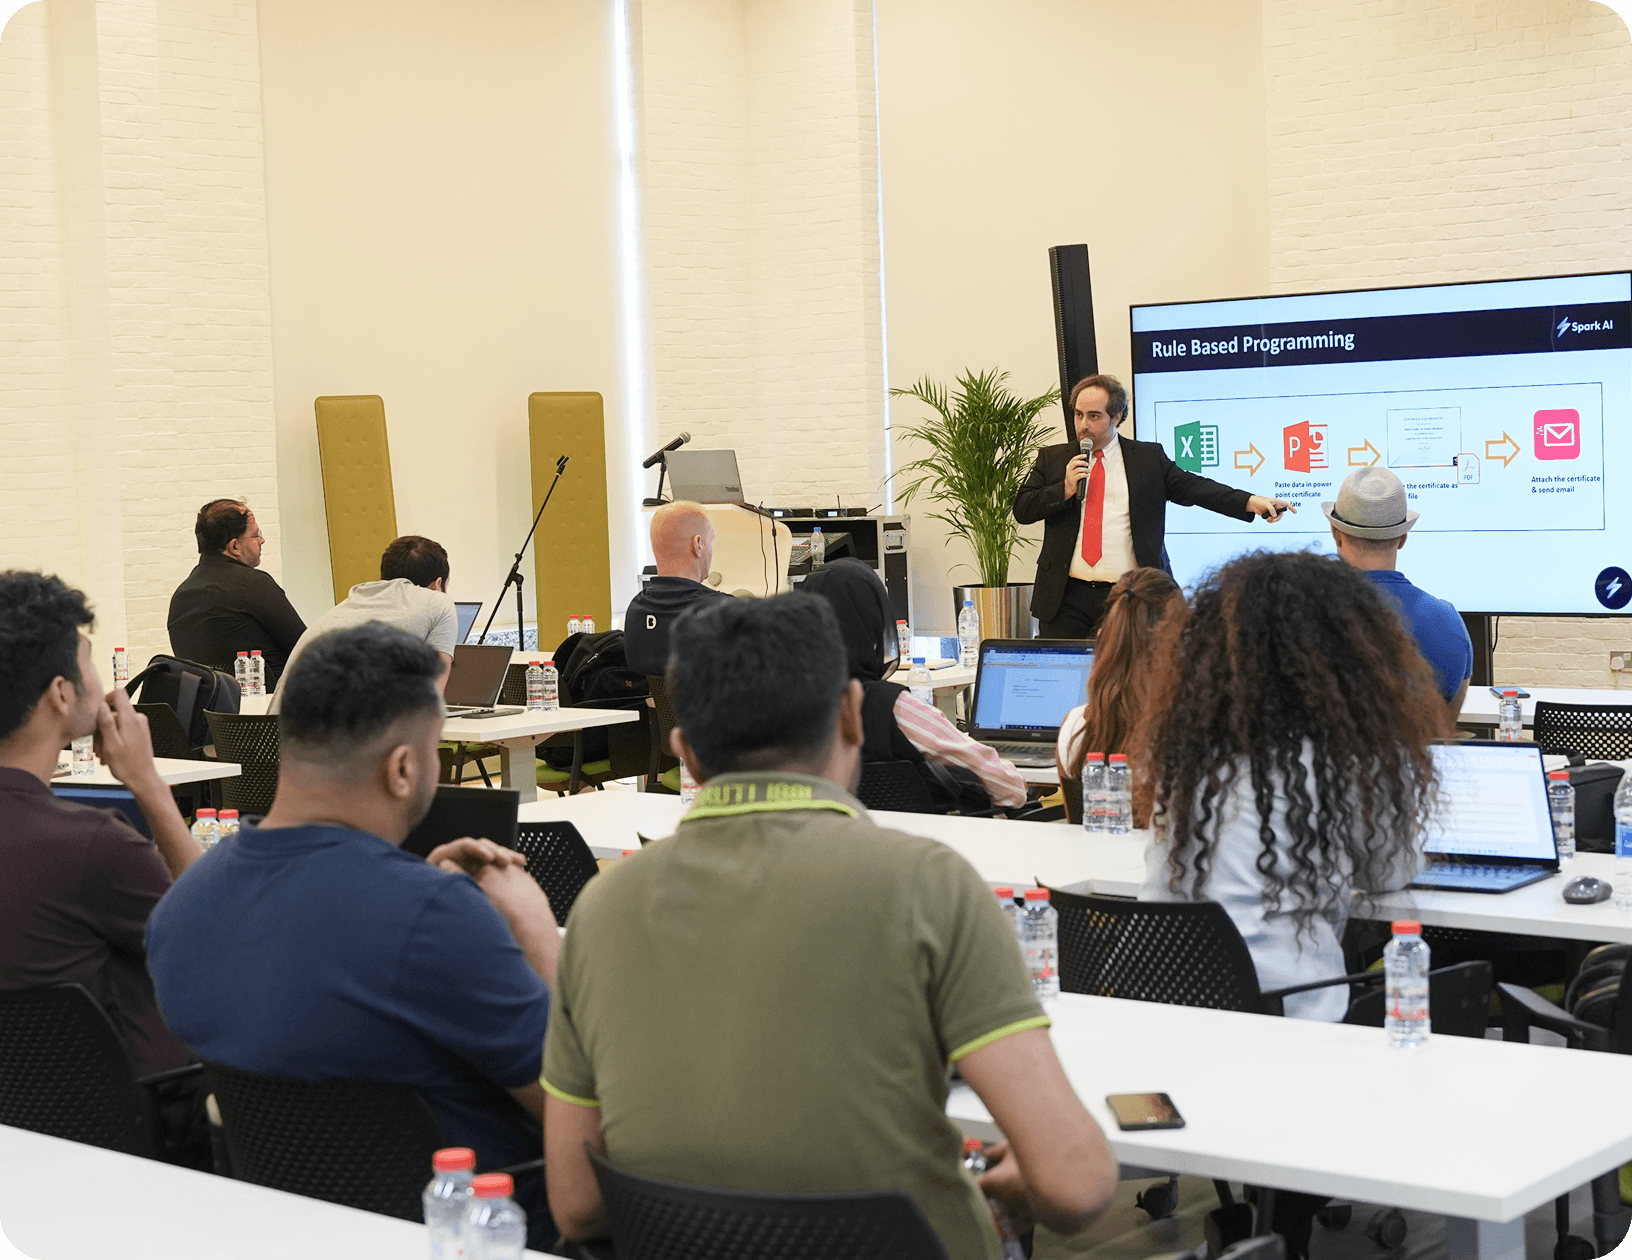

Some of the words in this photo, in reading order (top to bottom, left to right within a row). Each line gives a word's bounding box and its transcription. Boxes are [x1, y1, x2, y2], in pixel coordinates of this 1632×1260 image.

[1571, 320, 1601, 334] Spark
[1602, 319, 1613, 330] AI
[1152, 340, 1187, 358] Rule
[1191, 336, 1239, 356] Based
[1243, 330, 1355, 355] Programming
[1180, 435, 1194, 458] X
[1289, 436, 1301, 458] P
[1566, 474, 1601, 482] certificate
[1275, 491, 1291, 499] point
[1291, 490, 1321, 498] certificate
[646, 614, 657, 630] D
